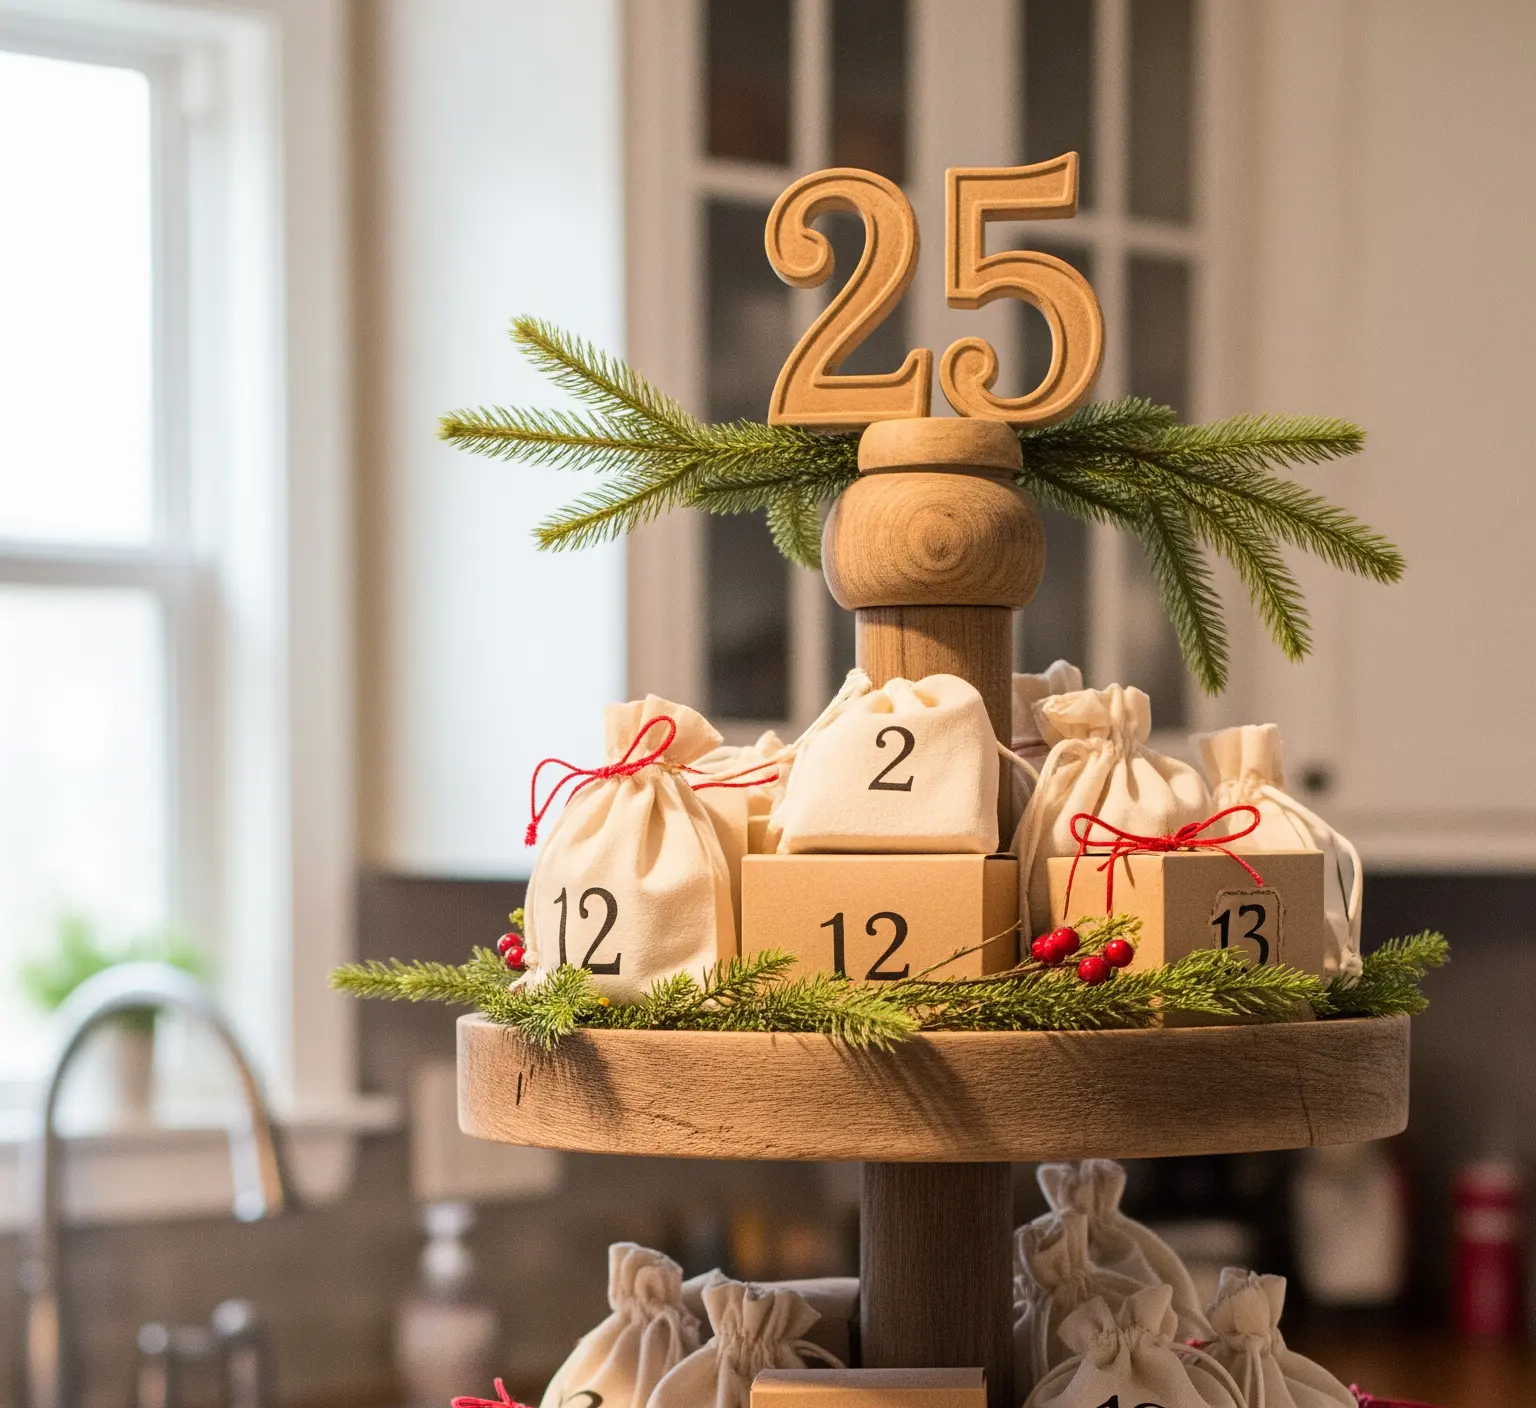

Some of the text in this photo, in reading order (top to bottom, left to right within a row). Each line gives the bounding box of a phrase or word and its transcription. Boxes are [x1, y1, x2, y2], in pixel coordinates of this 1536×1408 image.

[764, 151, 1106, 428] 25
[868, 725, 915, 792] 2
[553, 887, 622, 976] 12
[820, 911, 910, 981] 12
[1211, 904, 1269, 970] 13
